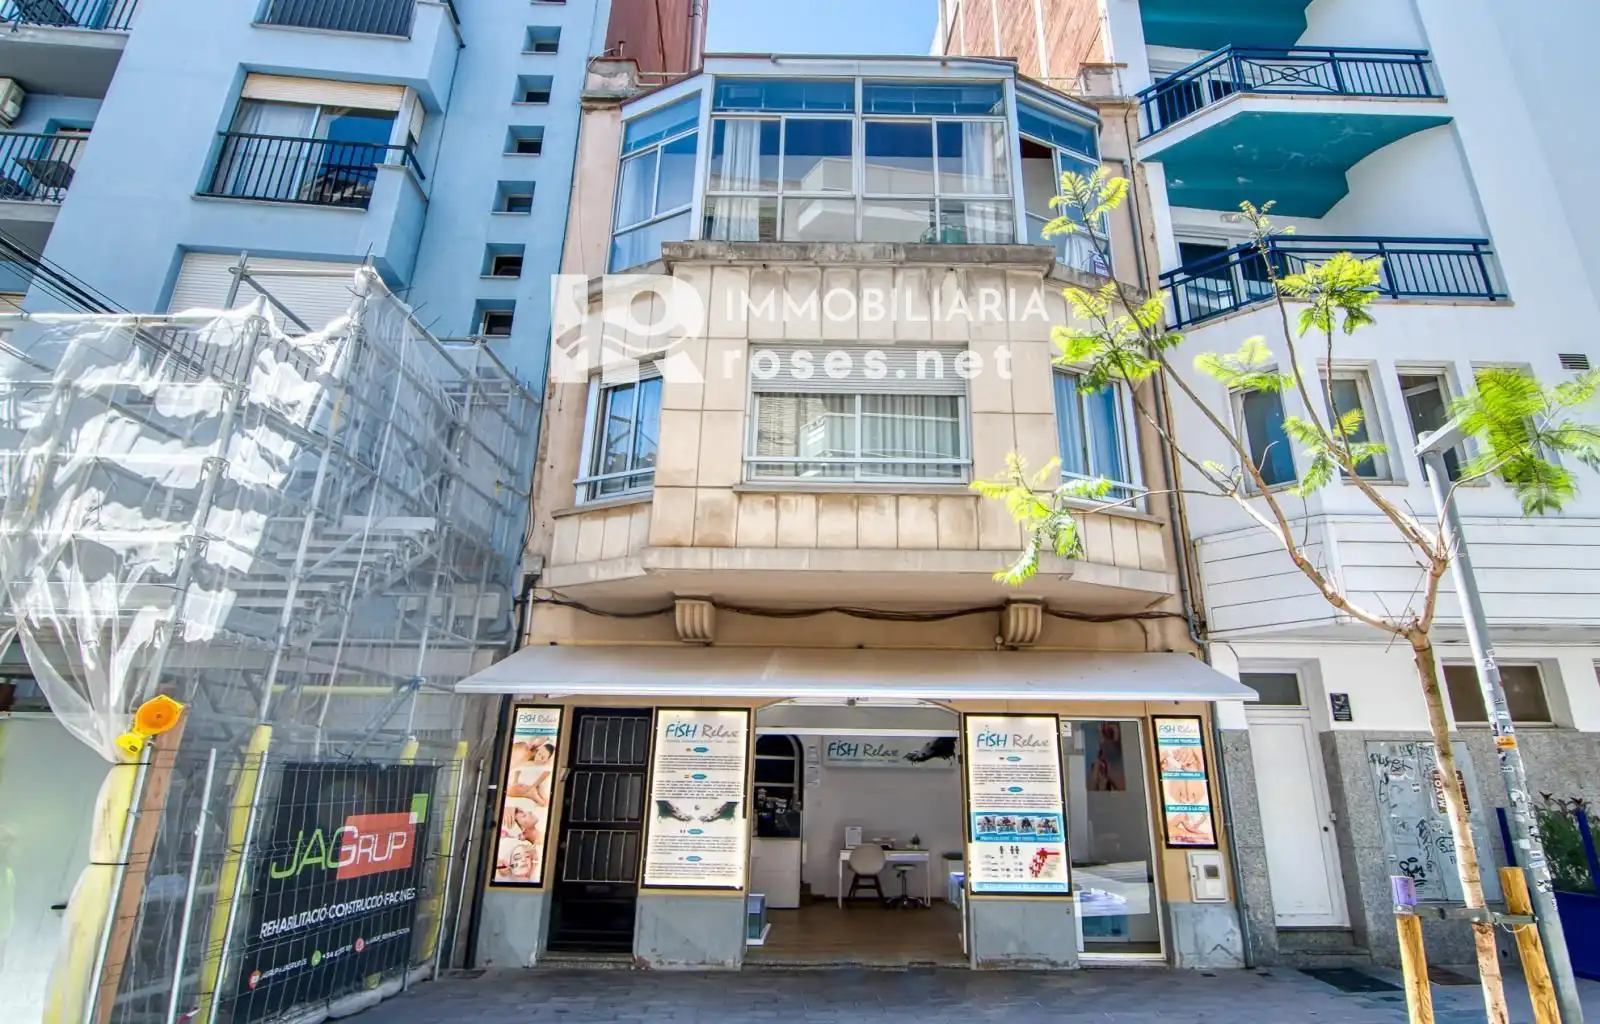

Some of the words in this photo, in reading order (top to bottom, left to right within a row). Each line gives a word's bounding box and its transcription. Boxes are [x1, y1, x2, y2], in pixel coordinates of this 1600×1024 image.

[702, 723, 740, 739] Relax
[1012, 733, 1050, 748] Relax
[862, 743, 899, 758] Relax
